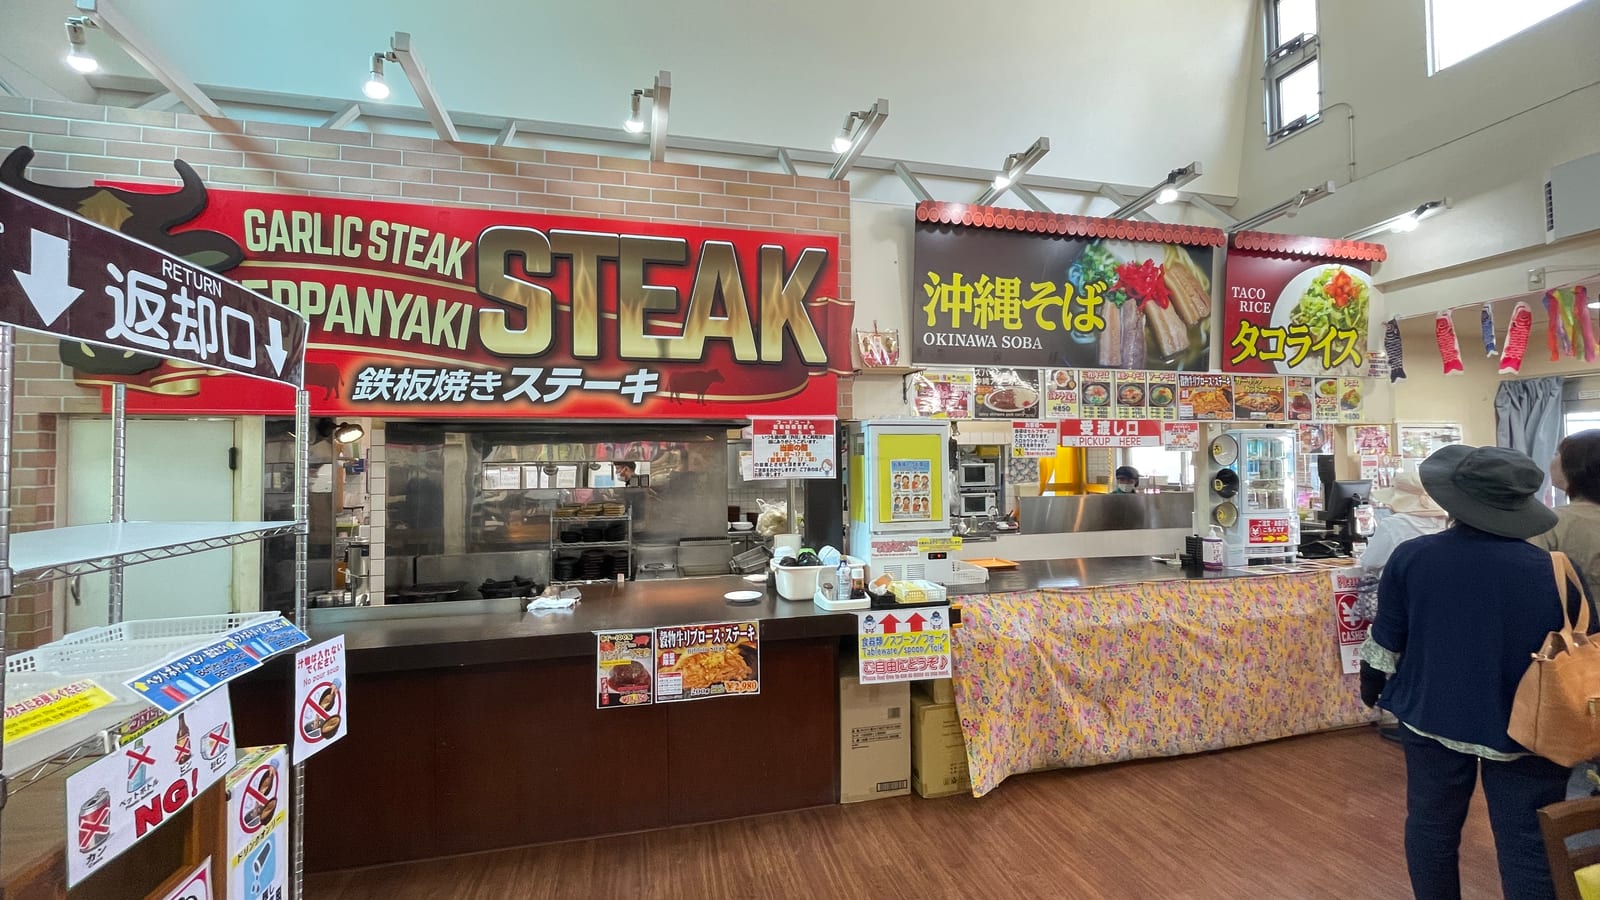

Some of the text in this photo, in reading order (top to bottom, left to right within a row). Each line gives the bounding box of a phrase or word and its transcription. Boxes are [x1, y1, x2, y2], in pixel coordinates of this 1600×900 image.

[244, 208, 472, 280] GARLIC STEAK
[162, 259, 223, 298] RETURN
[477, 225, 829, 364] STEAK
[922, 271, 1107, 333] 沖縄そば
[1231, 286, 1266, 300] TACO
[105, 263, 257, 368] 返却口
[241, 279, 473, 351] PPANYAKI
[1239, 301, 1271, 314] RICE
[923, 332, 1043, 350] OKINAWA SOBA
[1230, 319, 1362, 369] タコライス
[351, 367, 660, 404] 鉄板焼きステーキ
[1079, 437, 1142, 446] PICKUP HERE
[1080, 420, 1140, 436] 受渡し口
[659, 624, 756, 649] 穀物牛リブロース・ステーキ
[863, 656, 939, 674] ご自由にどうぞ
[303, 677, 312, 687] No
[725, 681, 758, 693] ¥2,980
[119, 779, 160, 808] ペットボトル
[134, 767, 198, 839] NG!
[86, 845, 107, 865] カン
